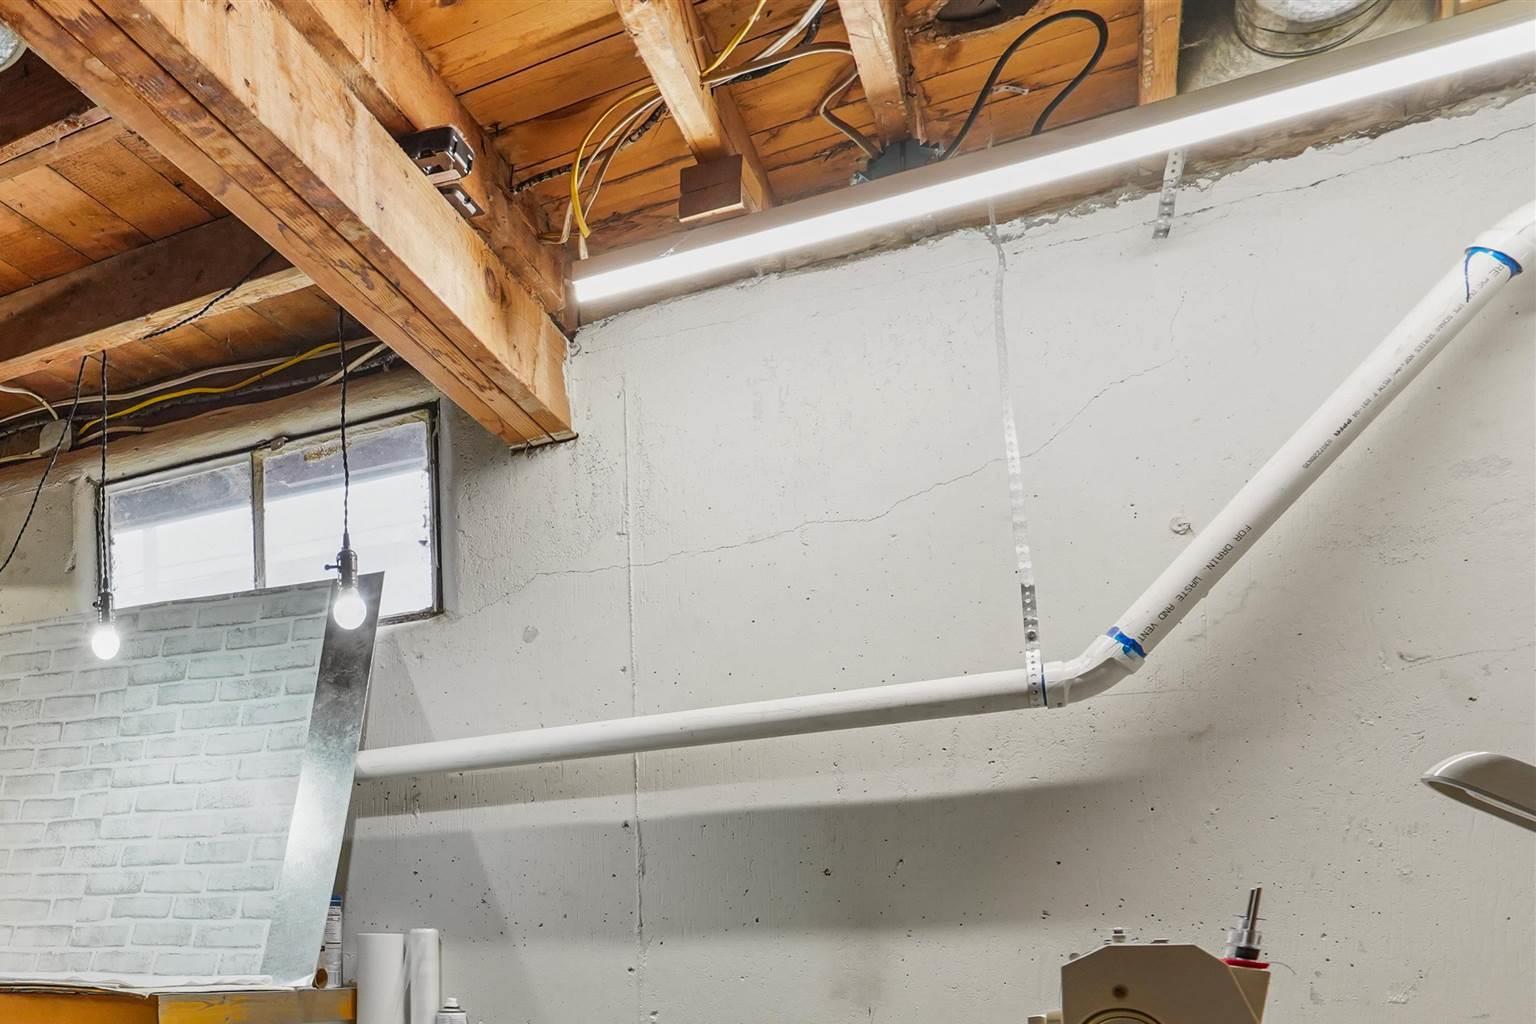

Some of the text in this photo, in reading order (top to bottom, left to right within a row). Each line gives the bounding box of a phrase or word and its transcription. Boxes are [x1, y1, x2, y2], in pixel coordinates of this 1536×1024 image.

[1231, 522, 1253, 544] FOR
[1174, 574, 1202, 603] WASTE
[1156, 602, 1176, 622] AND
[1135, 619, 1159, 643] VENT
